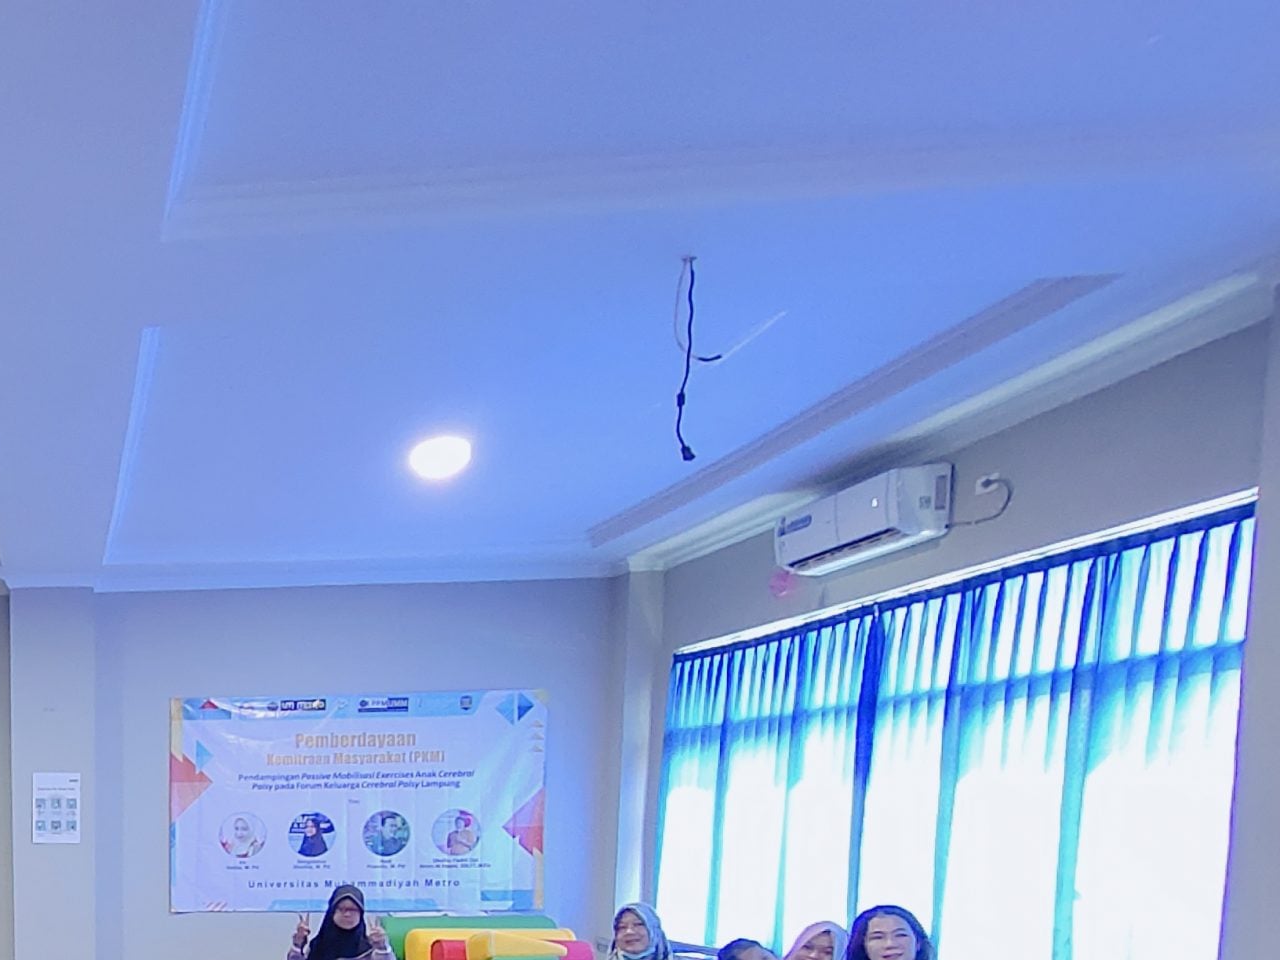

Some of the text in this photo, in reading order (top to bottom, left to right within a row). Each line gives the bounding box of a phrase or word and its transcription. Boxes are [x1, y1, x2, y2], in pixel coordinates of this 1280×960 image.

[295, 732, 416, 749] Pemberdayaan
[266, 751, 445, 766] Kemitraan Masyarakat (PKM)
[416, 770, 437, 778] Anak
[274, 783, 295, 791] pada
[296, 782, 322, 790] Forum
[248, 880, 319, 888] Universitas
[425, 878, 460, 887] Metro
